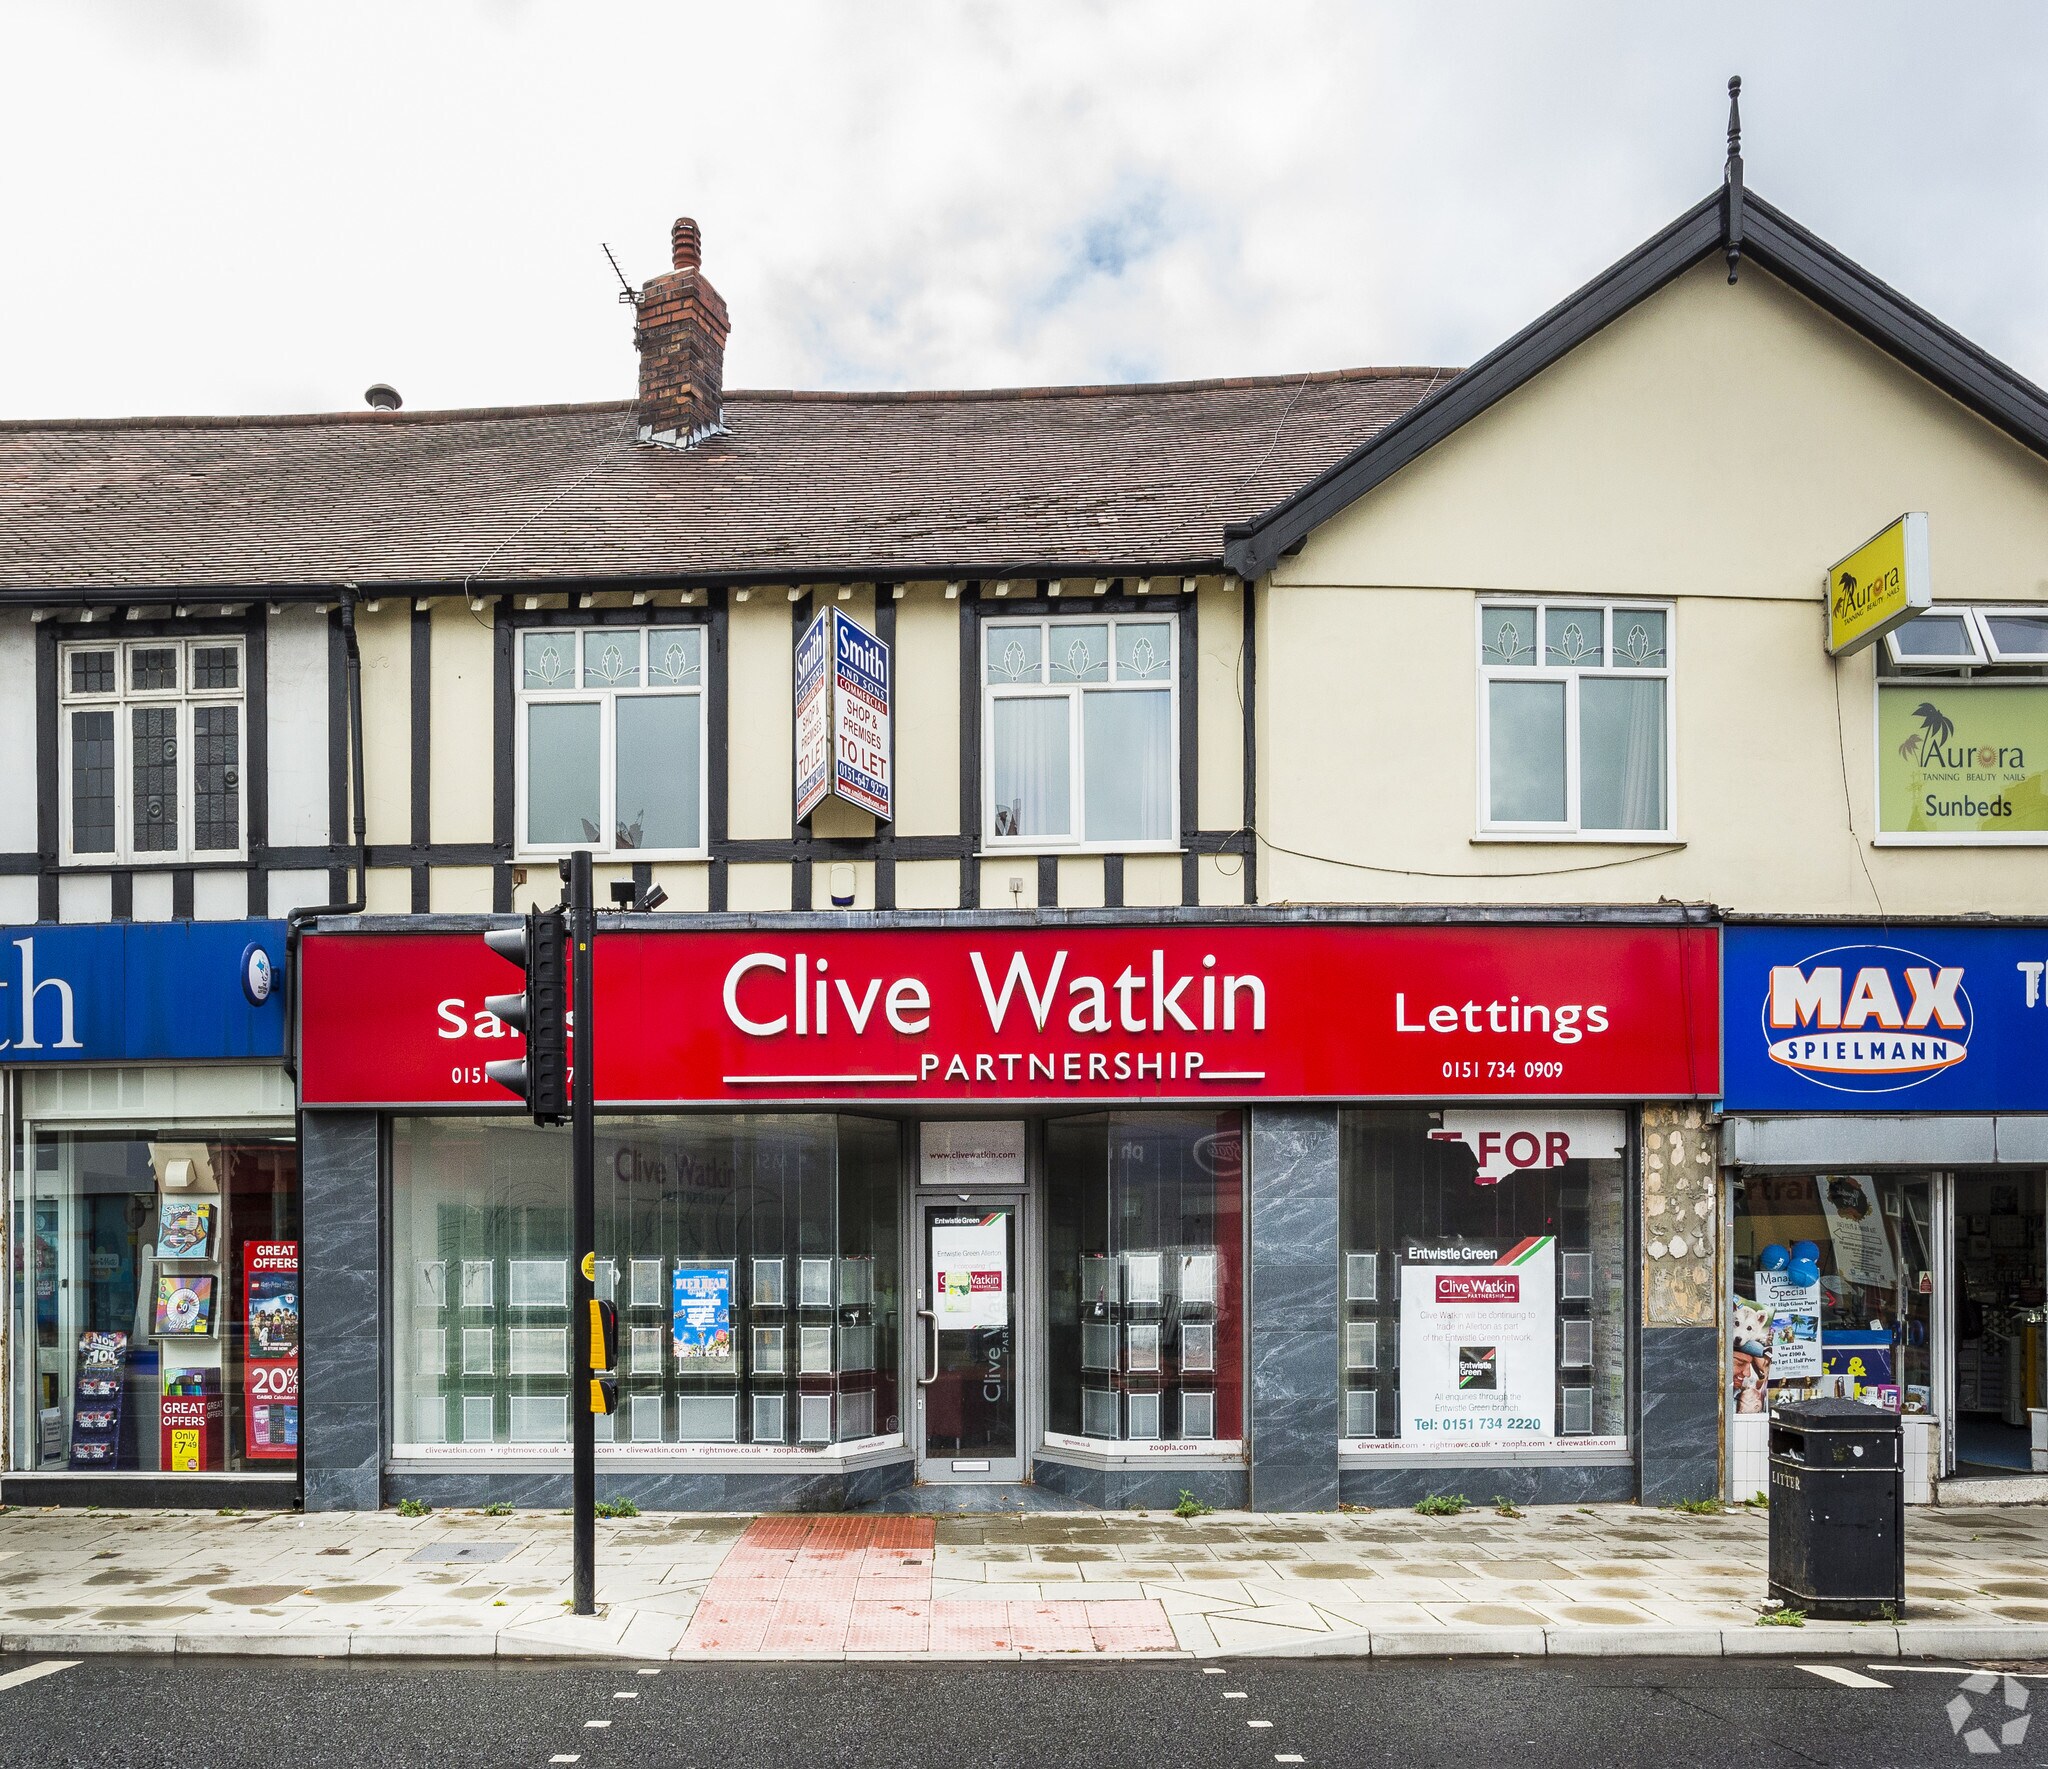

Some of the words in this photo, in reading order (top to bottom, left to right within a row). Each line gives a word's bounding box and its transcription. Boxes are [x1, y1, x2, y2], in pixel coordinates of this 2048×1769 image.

[1845, 567, 1900, 612] Aurora
[1867, 596, 1884, 613] BEAUTY
[1886, 587, 1900, 600] NAILS
[798, 626, 822, 686] Smith
[840, 625, 884, 683] Smith
[841, 665, 859, 683] AND
[863, 680, 885, 700] SONS
[840, 678, 886, 714] COMMERCIAL
[847, 699, 870, 723] SHOP
[871, 715, 878, 730] &
[844, 716, 881, 749] PREMISES
[840, 734, 857, 764] TO
[862, 748, 887, 779] LET
[1924, 739, 2025, 768] Aurora
[1923, 773, 1960, 781] TANNING
[1967, 773, 1996, 781] BEAUTY
[2003, 773, 2025, 781] NAILS
[871, 780, 887, 799] 9272
[1926, 794, 2012, 817] Sunbeds
[723, 952, 931, 1036] Clive
[970, 949, 1266, 1033] Watkin
[1769, 965, 1966, 1029] MAX
[1396, 992, 1609, 1044] Lettings
[1788, 1041, 1947, 1060] SPIELMANN
[921, 1052, 1205, 1082] PARTNERSHIP
[1442, 1061, 1479, 1078] 0151
[1487, 1061, 1516, 1078] 734
[1524, 1061, 1563, 1078] 0909
[929, 1151, 1016, 1159] www.clivewatkin.com
[1478, 1131, 1570, 1168] FOR
[934, 1217, 961, 1225] Entwistle
[256, 1245, 295, 1256] GREAT
[1409, 1247, 1460, 1260] Entwistle
[1461, 1248, 1498, 1260] Green
[253, 1258, 298, 1268] OFFERS
[1439, 1280, 1469, 1293] Clive
[1470, 1280, 1516, 1293] Watkin
[1768, 1285, 1808, 1301] Special
[1420, 1311, 1438, 1319] Clive
[1477, 1311, 1487, 1319] be
[1488, 1311, 1527, 1320] continuing
[1436, 1322, 1455, 1331] trade
[1457, 1322, 1464, 1330] in
[1465, 1322, 1491, 1331] Allerton
[1503, 1323, 1519, 1332] part
[1423, 1333, 1430, 1342] of
[1431, 1333, 1443, 1342] the
[1445, 1333, 1477, 1342] Entwistle
[1479, 1333, 1500, 1342] Green
[1459, 1361, 1492, 1370] Entwistle
[1460, 1368, 1482, 1376] Green
[983, 1347, 1001, 1402] Clive
[1434, 1392, 1444, 1400] All
[1479, 1392, 1508, 1403] through
[162, 1402, 205, 1414] GREAT
[1435, 1403, 1467, 1412] Entwistle
[1468, 1403, 1490, 1412] Green
[162, 1416, 205, 1426] OFFERS
[1414, 1418, 1437, 1430] Tel:
[1442, 1418, 1474, 1430] 0151
[1479, 1418, 1502, 1430] 734
[1507, 1417, 1540, 1430] 2220
[175, 1431, 196, 1441] Only
[1357, 1441, 1418, 1450] clivewatkin.com
[1430, 1440, 1491, 1450] rightmove.co.uk
[1502, 1440, 1545, 1450] zoopla.com
[1556, 1438, 1616, 1447] clivewatkin.com
[425, 1446, 486, 1454] clivewatkin.com
[497, 1446, 559, 1455] rightmove.co.uk
[626, 1446, 687, 1454] clivewatkin.com
[699, 1446, 761, 1455] rightmove.co.uk
[773, 1445, 817, 1455] zoopla.com
[1149, 1444, 1197, 1452] zoopla.com
[1772, 1471, 1801, 1491] LITTER
